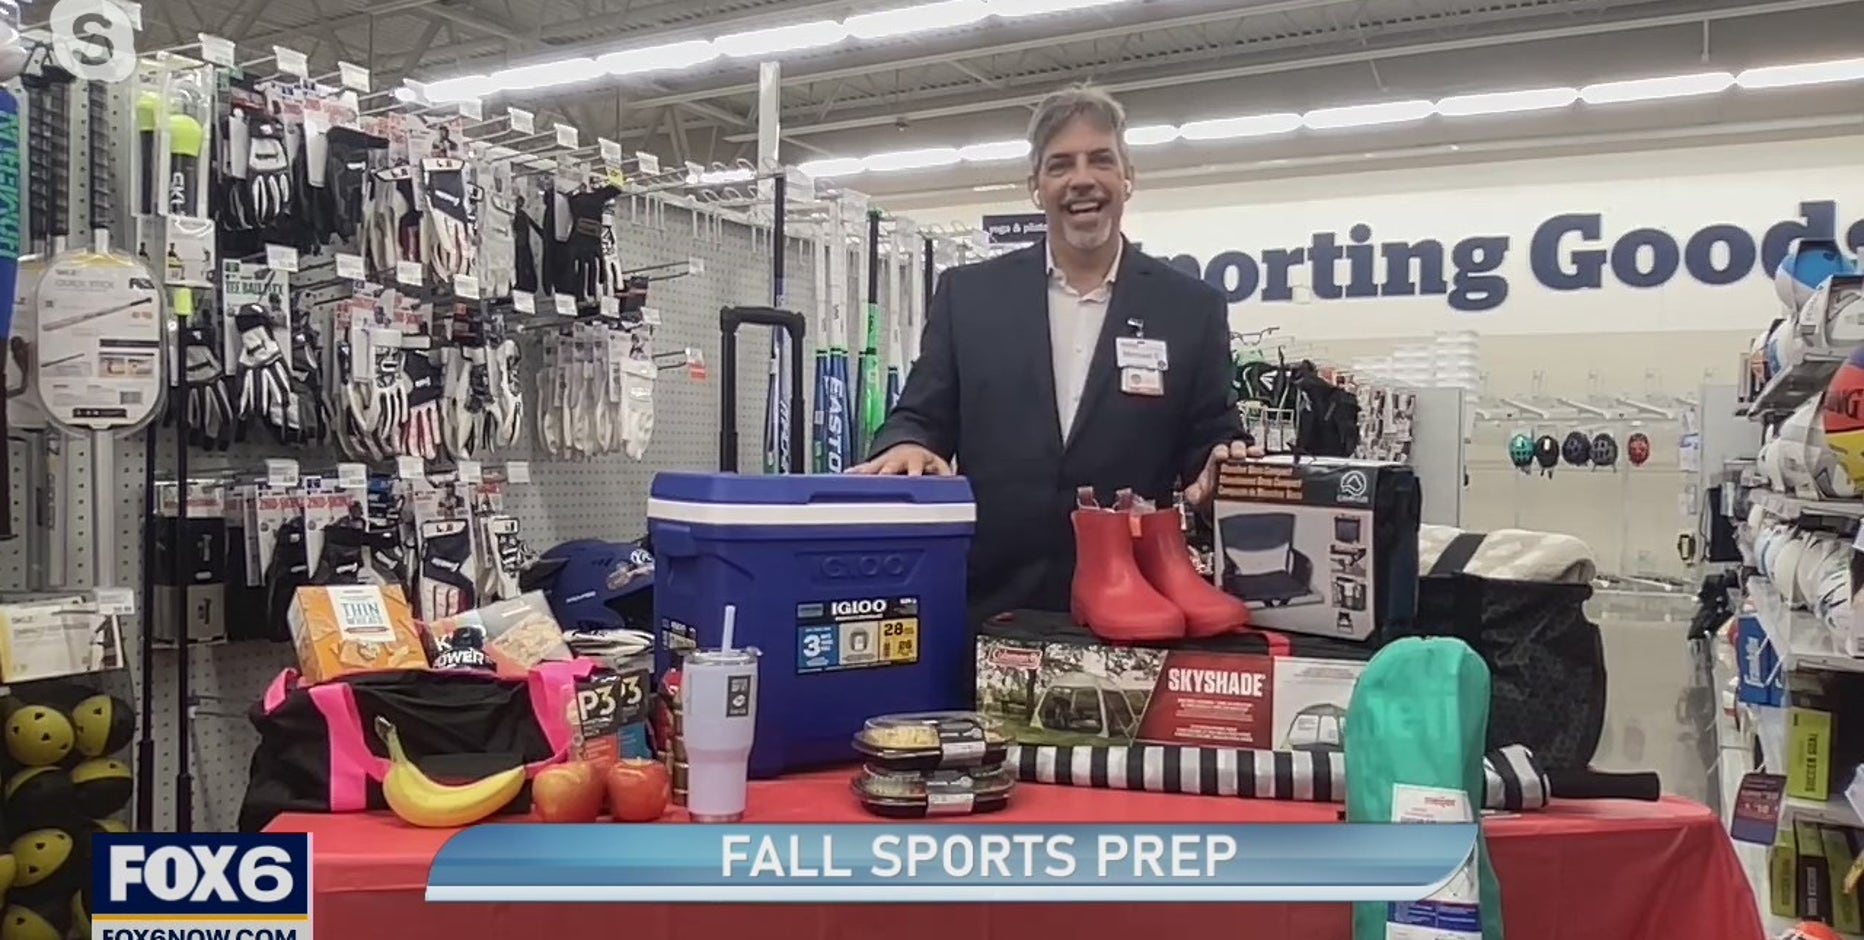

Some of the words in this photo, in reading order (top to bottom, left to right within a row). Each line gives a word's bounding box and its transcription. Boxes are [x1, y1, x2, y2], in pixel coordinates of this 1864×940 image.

[1131, 223, 1511, 311] orting
[1530, 200, 1864, 293] Good
[827, 376, 843, 474] EASTO
[340, 601, 380, 616] THIN
[831, 599, 887, 616] IGLOO
[884, 622, 904, 636] 28
[803, 634, 821, 657] 3
[621, 675, 643, 704] 3
[1167, 667, 1264, 697] SKYSHADE
[577, 685, 617, 721] P3
